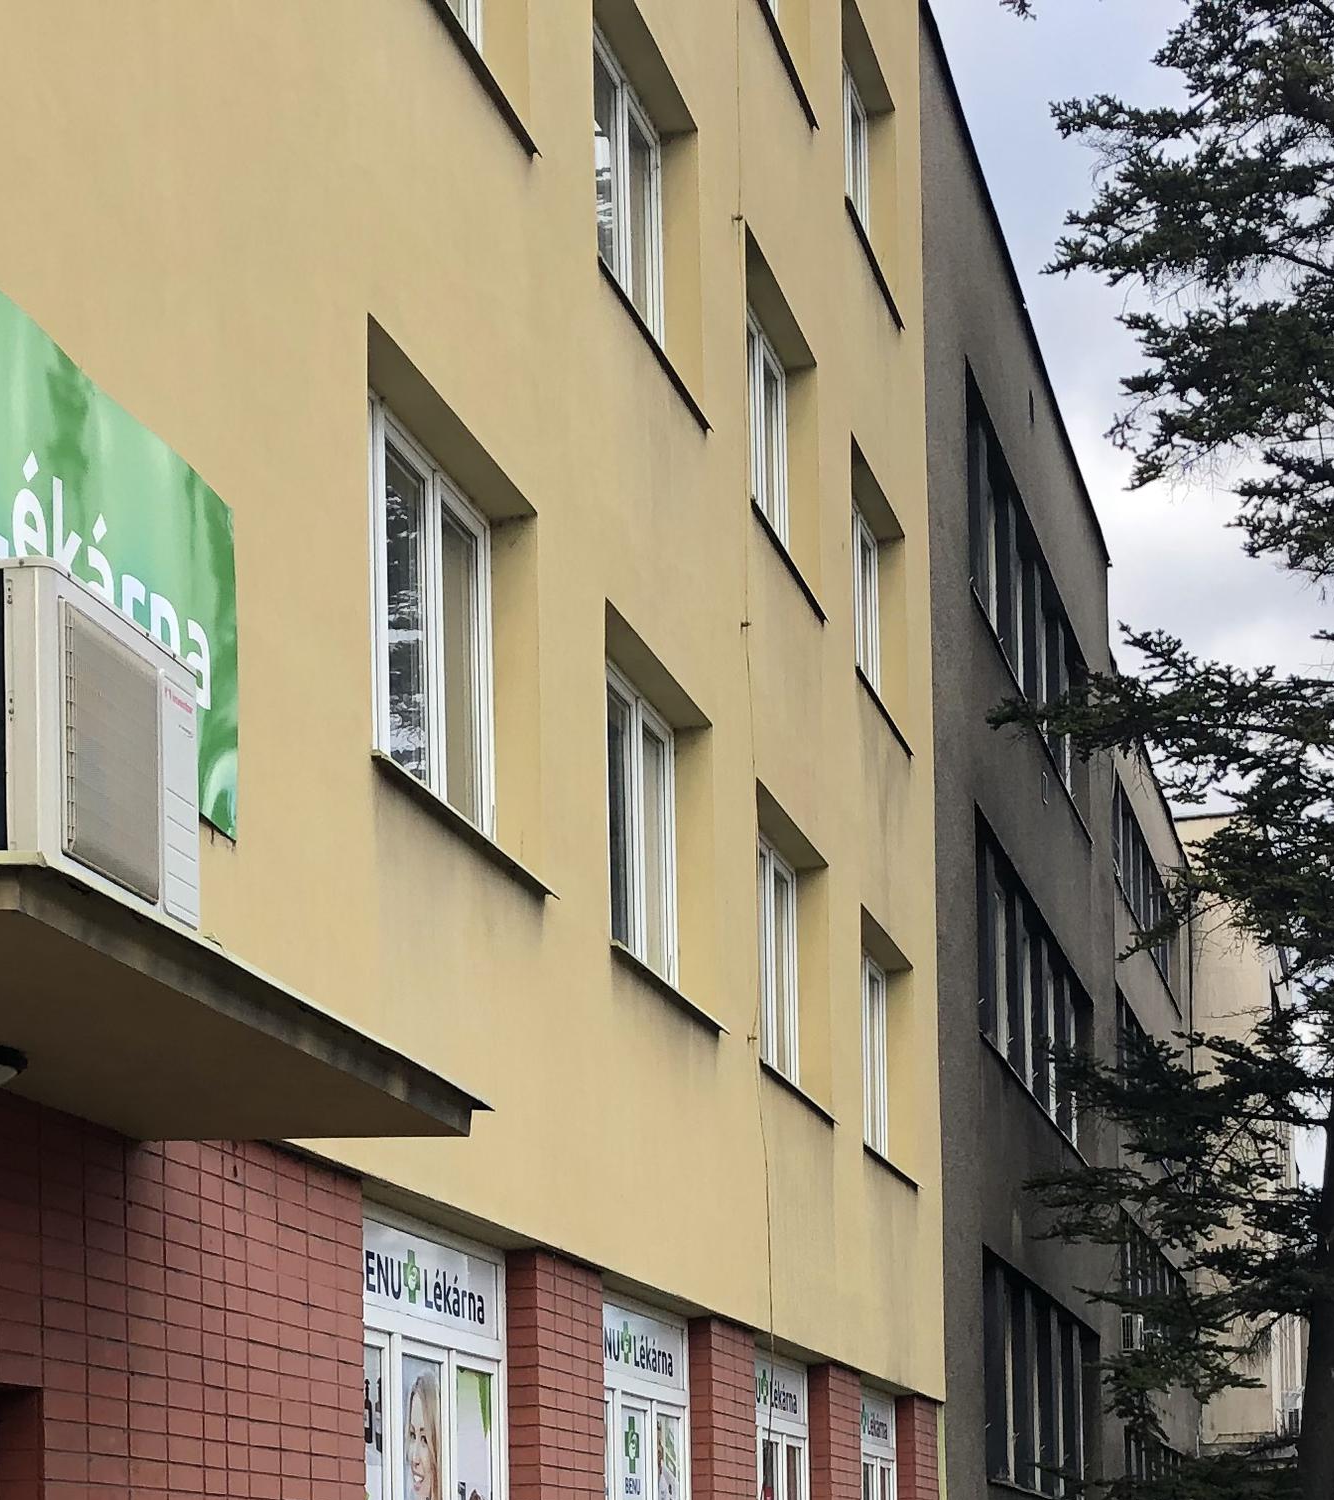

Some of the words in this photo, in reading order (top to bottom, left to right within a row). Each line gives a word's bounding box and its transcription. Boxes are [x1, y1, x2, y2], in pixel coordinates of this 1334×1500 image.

[424, 1268, 485, 1325] Lékárna
[633, 1333, 673, 1377] Lékárna
[624, 1476, 641, 1495] BENU
